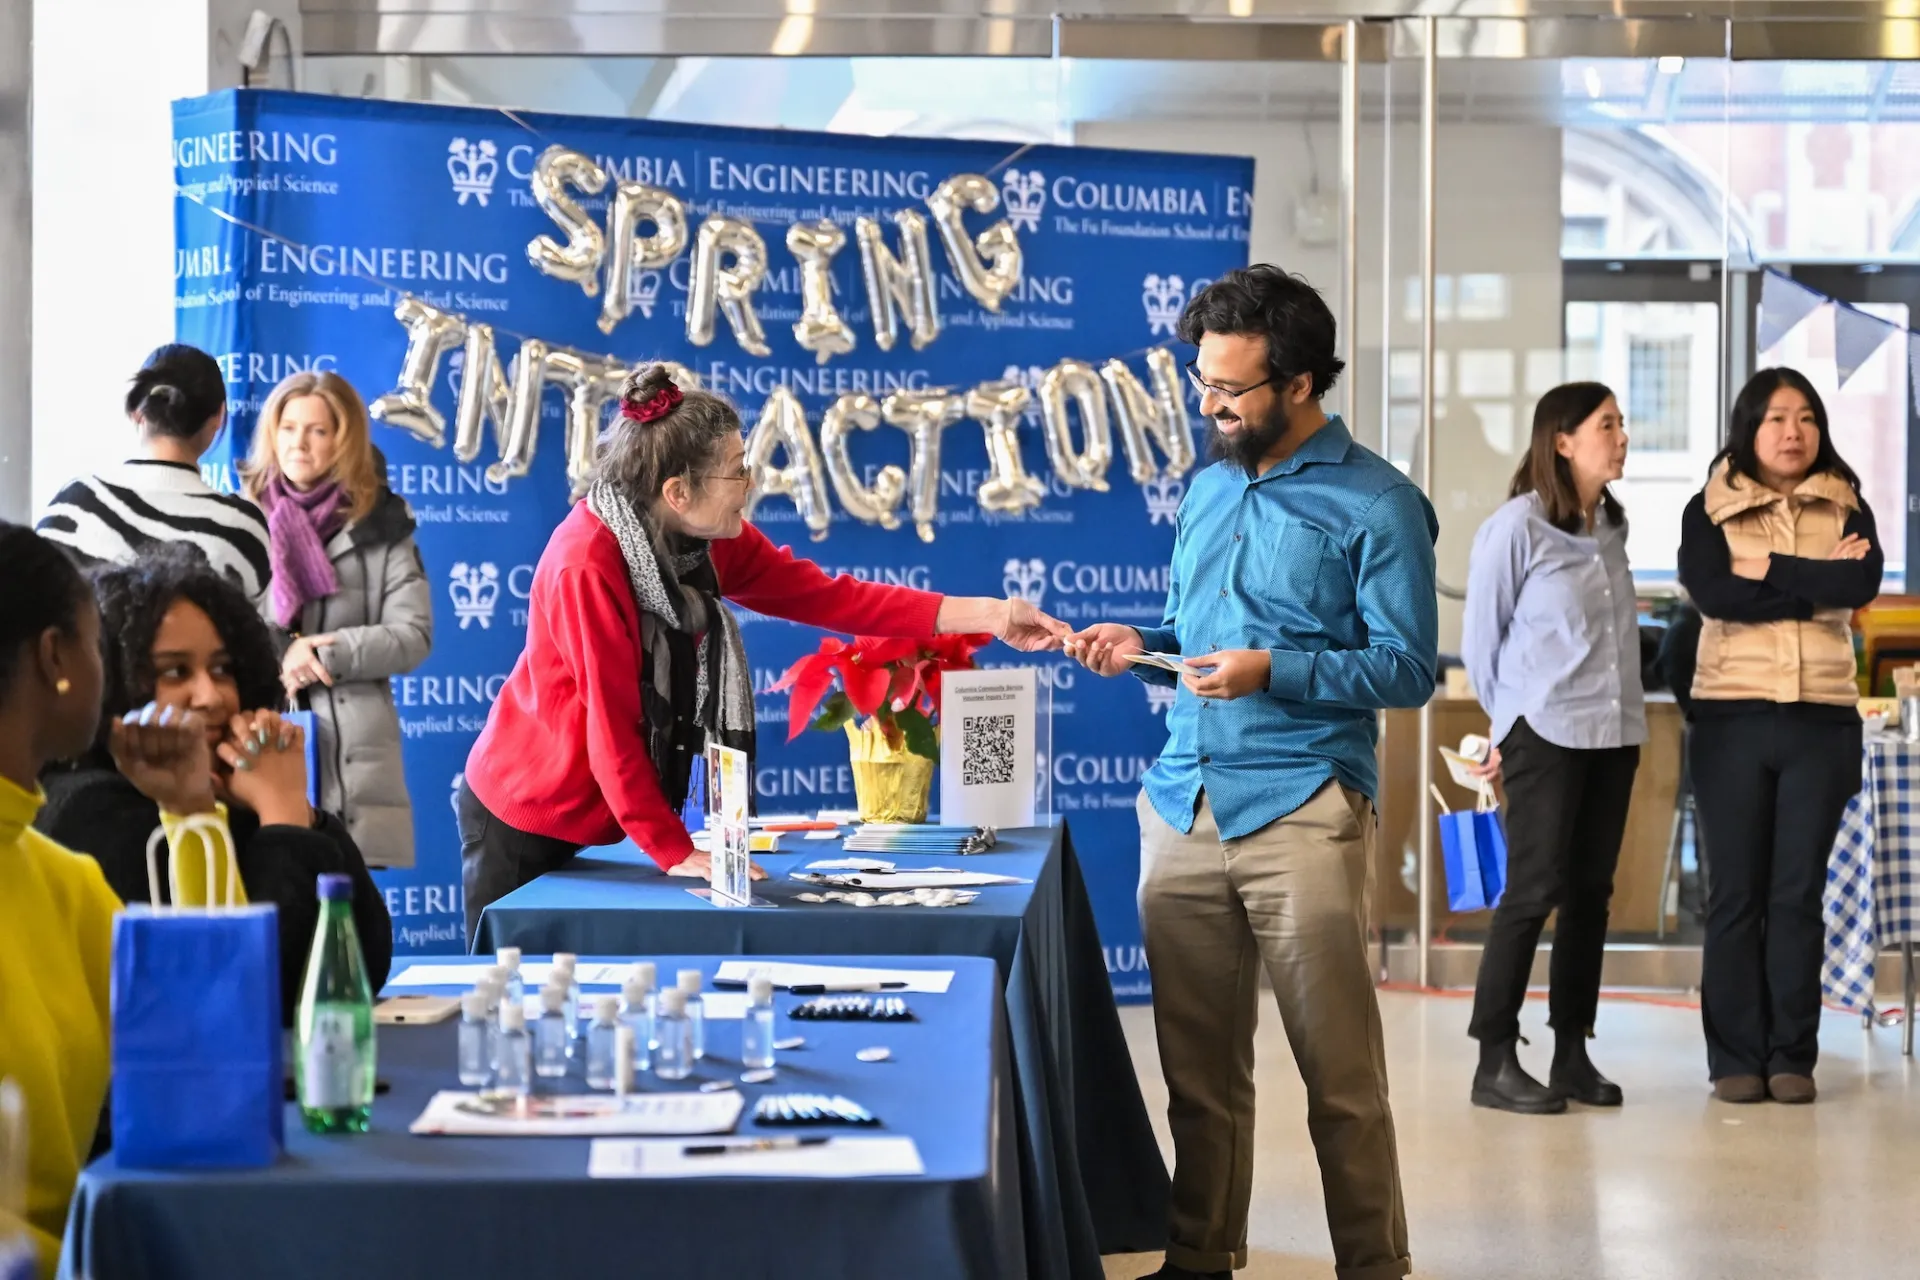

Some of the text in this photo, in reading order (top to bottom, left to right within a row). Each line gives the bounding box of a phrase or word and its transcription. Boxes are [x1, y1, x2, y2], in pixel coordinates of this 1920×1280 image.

[172, 130, 338, 168] GINEERING
[284, 173, 339, 195] Science
[506, 144, 930, 200] CMBIA ENGINEERING
[1052, 176, 1207, 216] COLUMBIA
[260, 238, 508, 284] ENGINEERING
[526, 143, 1022, 362] SPRING
[245, 282, 264, 301] of
[268, 283, 360, 311] Engineering
[362, 288, 391, 307] and
[455, 291, 509, 311] Science
[369, 291, 1196, 542] INTACTION
[455, 505, 510, 523] Science
[1052, 561, 1171, 594] COLUM
[398, 923, 456, 948] Applied
